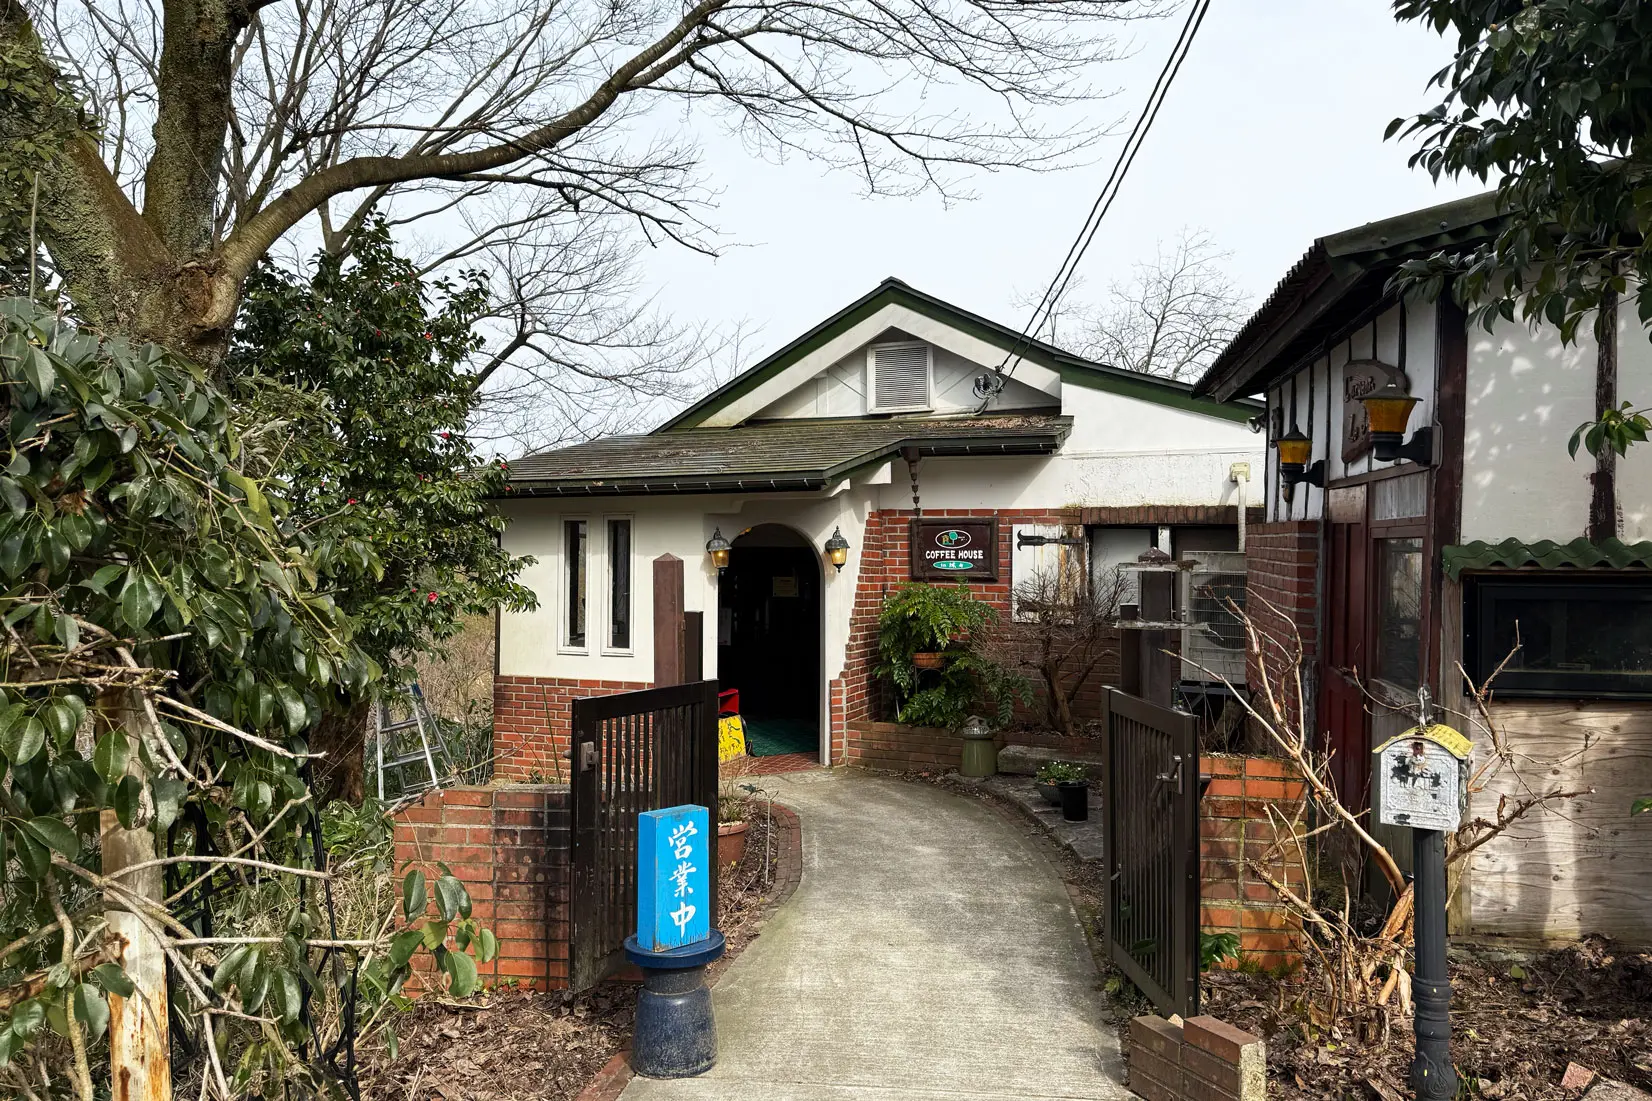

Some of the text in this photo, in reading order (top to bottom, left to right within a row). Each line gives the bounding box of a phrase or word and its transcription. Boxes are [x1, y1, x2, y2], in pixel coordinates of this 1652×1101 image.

[925, 550, 984, 560] COFFEE HOUSE
[668, 820, 699, 938] 営業中
